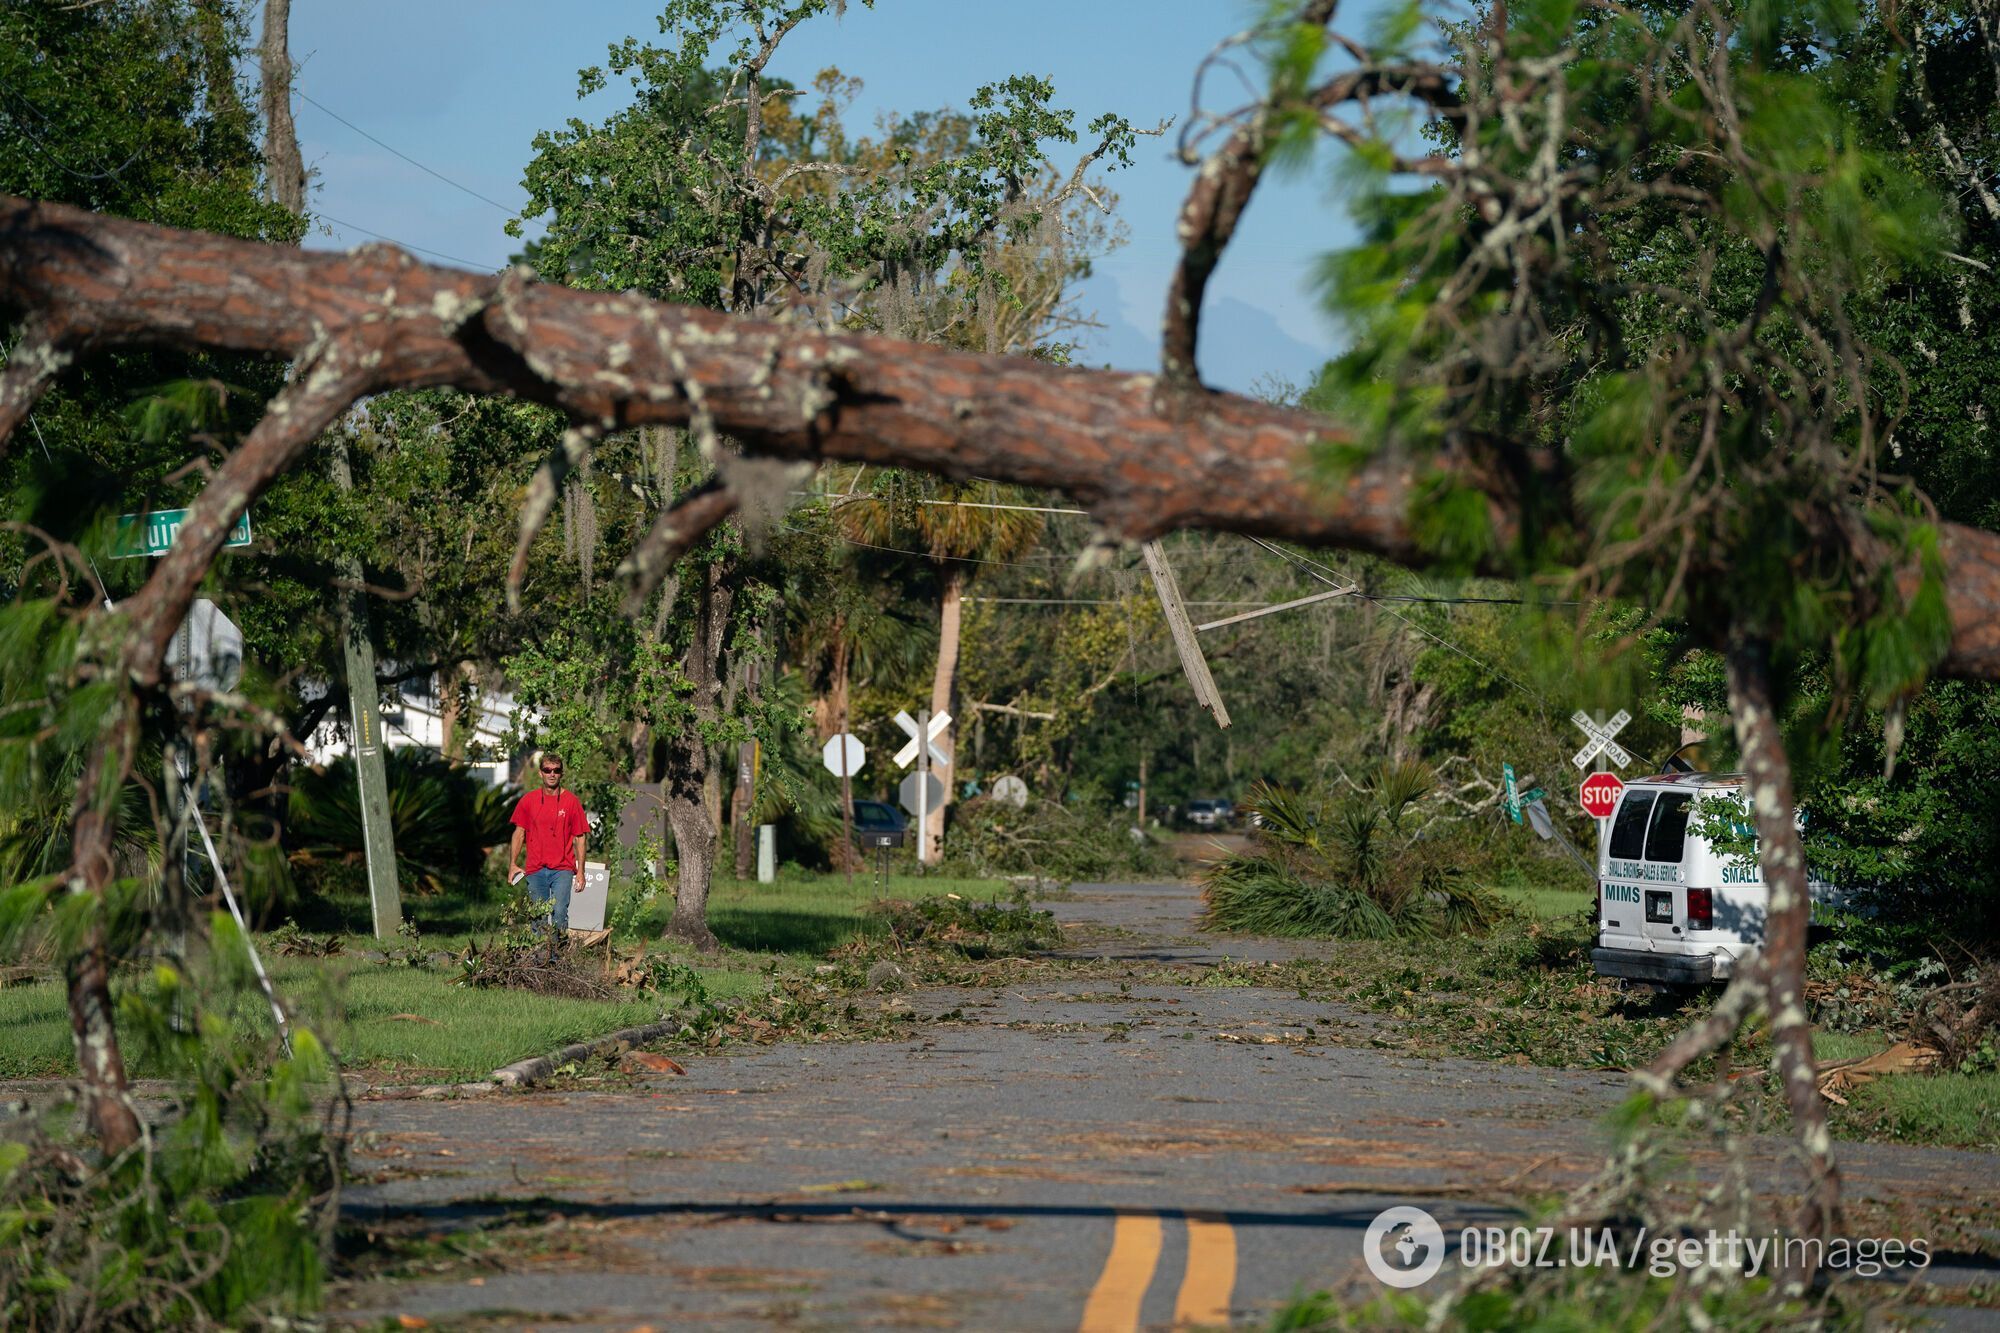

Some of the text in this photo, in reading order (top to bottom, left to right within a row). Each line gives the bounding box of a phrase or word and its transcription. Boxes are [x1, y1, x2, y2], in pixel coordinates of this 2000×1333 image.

[1576, 712, 1628, 766] CROSSING
[1583, 786, 1622, 805] STOP
[1609, 861, 1622, 877] SMALL
[1643, 864, 1656, 880] SALES
[1660, 866, 1678, 882] SERVICE
[1722, 867, 1759, 883] SMALL
[1605, 884, 1640, 903] MIMS
